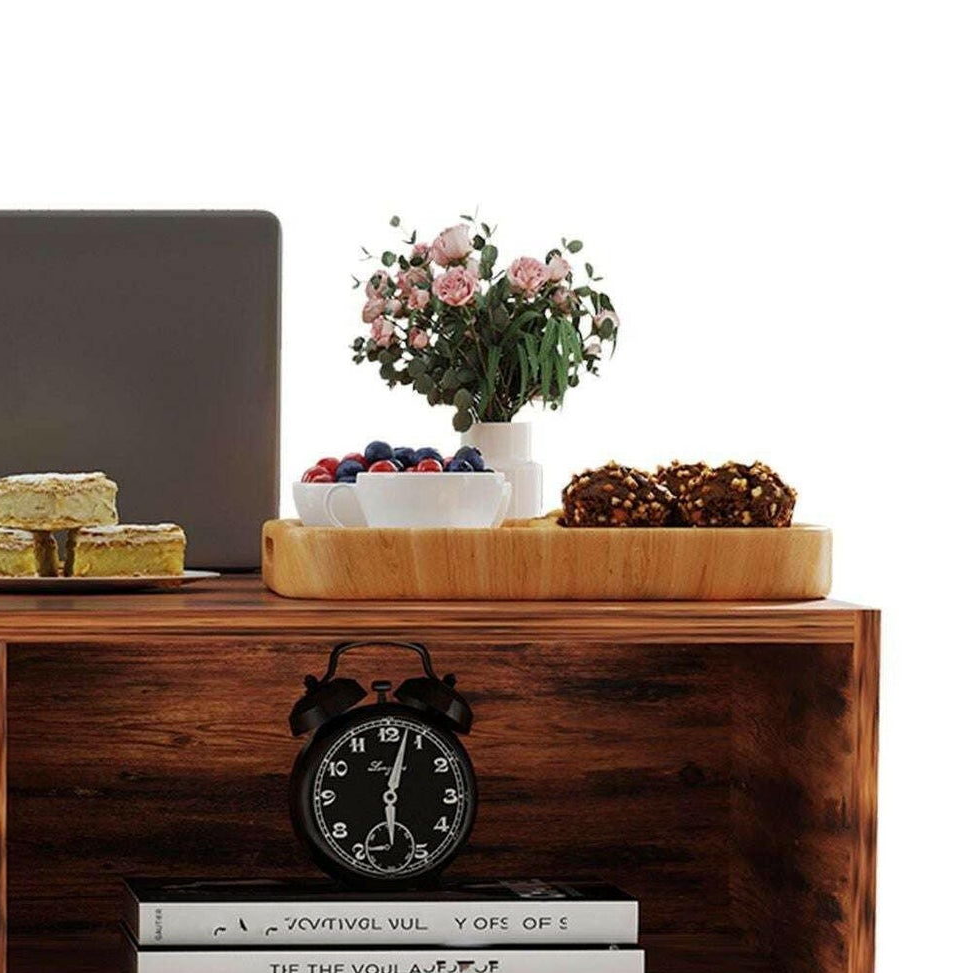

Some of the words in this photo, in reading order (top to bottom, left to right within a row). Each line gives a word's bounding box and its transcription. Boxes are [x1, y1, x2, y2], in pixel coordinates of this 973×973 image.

[377, 727, 401, 742] 12
[413, 735, 423, 750] 1
[349, 737, 366, 752] 11
[327, 760, 348, 777] 10
[433, 757, 449, 773] 2
[320, 789, 336, 806] 9
[443, 788, 458, 804] 3
[332, 821, 348, 839] 8
[433, 816, 450, 832] 4
[414, 843, 428, 859] 5
